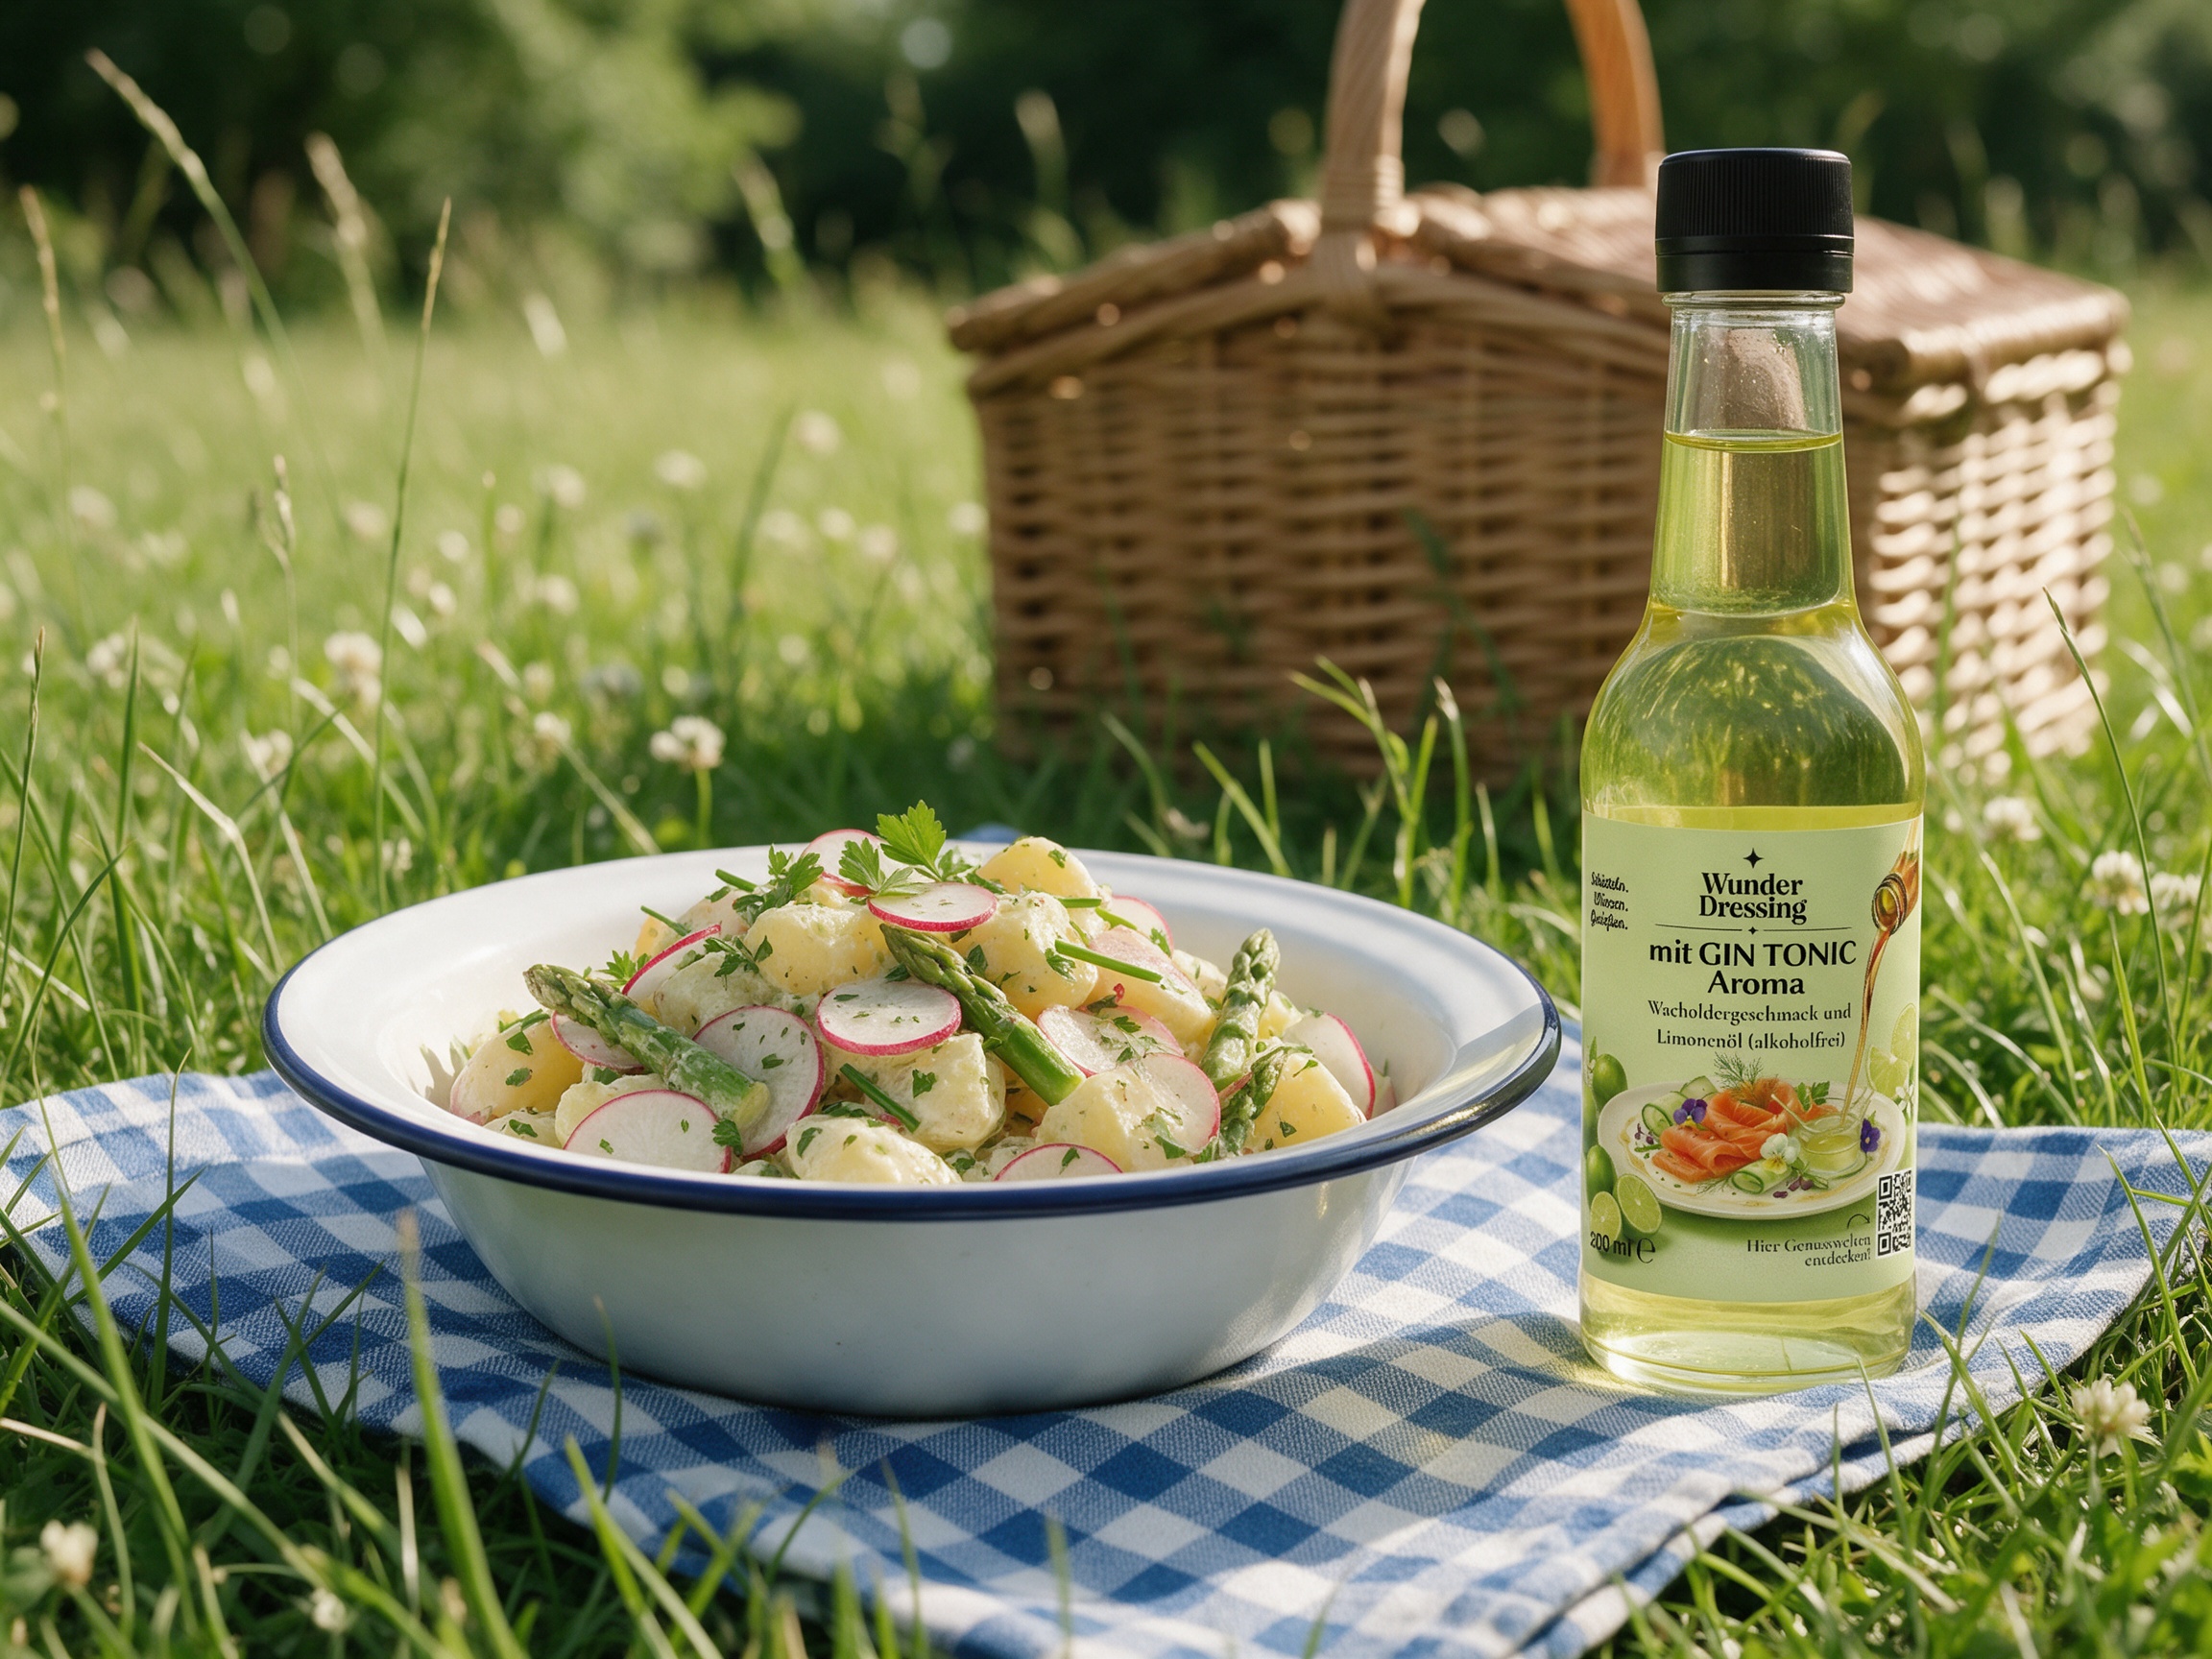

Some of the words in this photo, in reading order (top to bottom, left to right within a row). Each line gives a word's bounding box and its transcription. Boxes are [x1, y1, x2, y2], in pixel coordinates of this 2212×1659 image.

[1701, 872, 1804, 896] Wunder
[1698, 895, 1808, 926] Dressing
[1649, 938, 1693, 965] mit
[1698, 942, 1754, 967] GIN
[1763, 940, 1857, 967] TONIC
[1707, 970, 1805, 995] Aroma
[1647, 999, 1818, 1026] Wacholdergeschmack
[1823, 1001, 1851, 1021] und
[1657, 1028, 1743, 1048] Limonenöl
[1748, 1031, 1845, 1050] (alkoholfrei)
[1590, 1231, 1610, 1253] 200
[1613, 1238, 1632, 1258] ml
[1747, 1238, 1781, 1253] Hier
